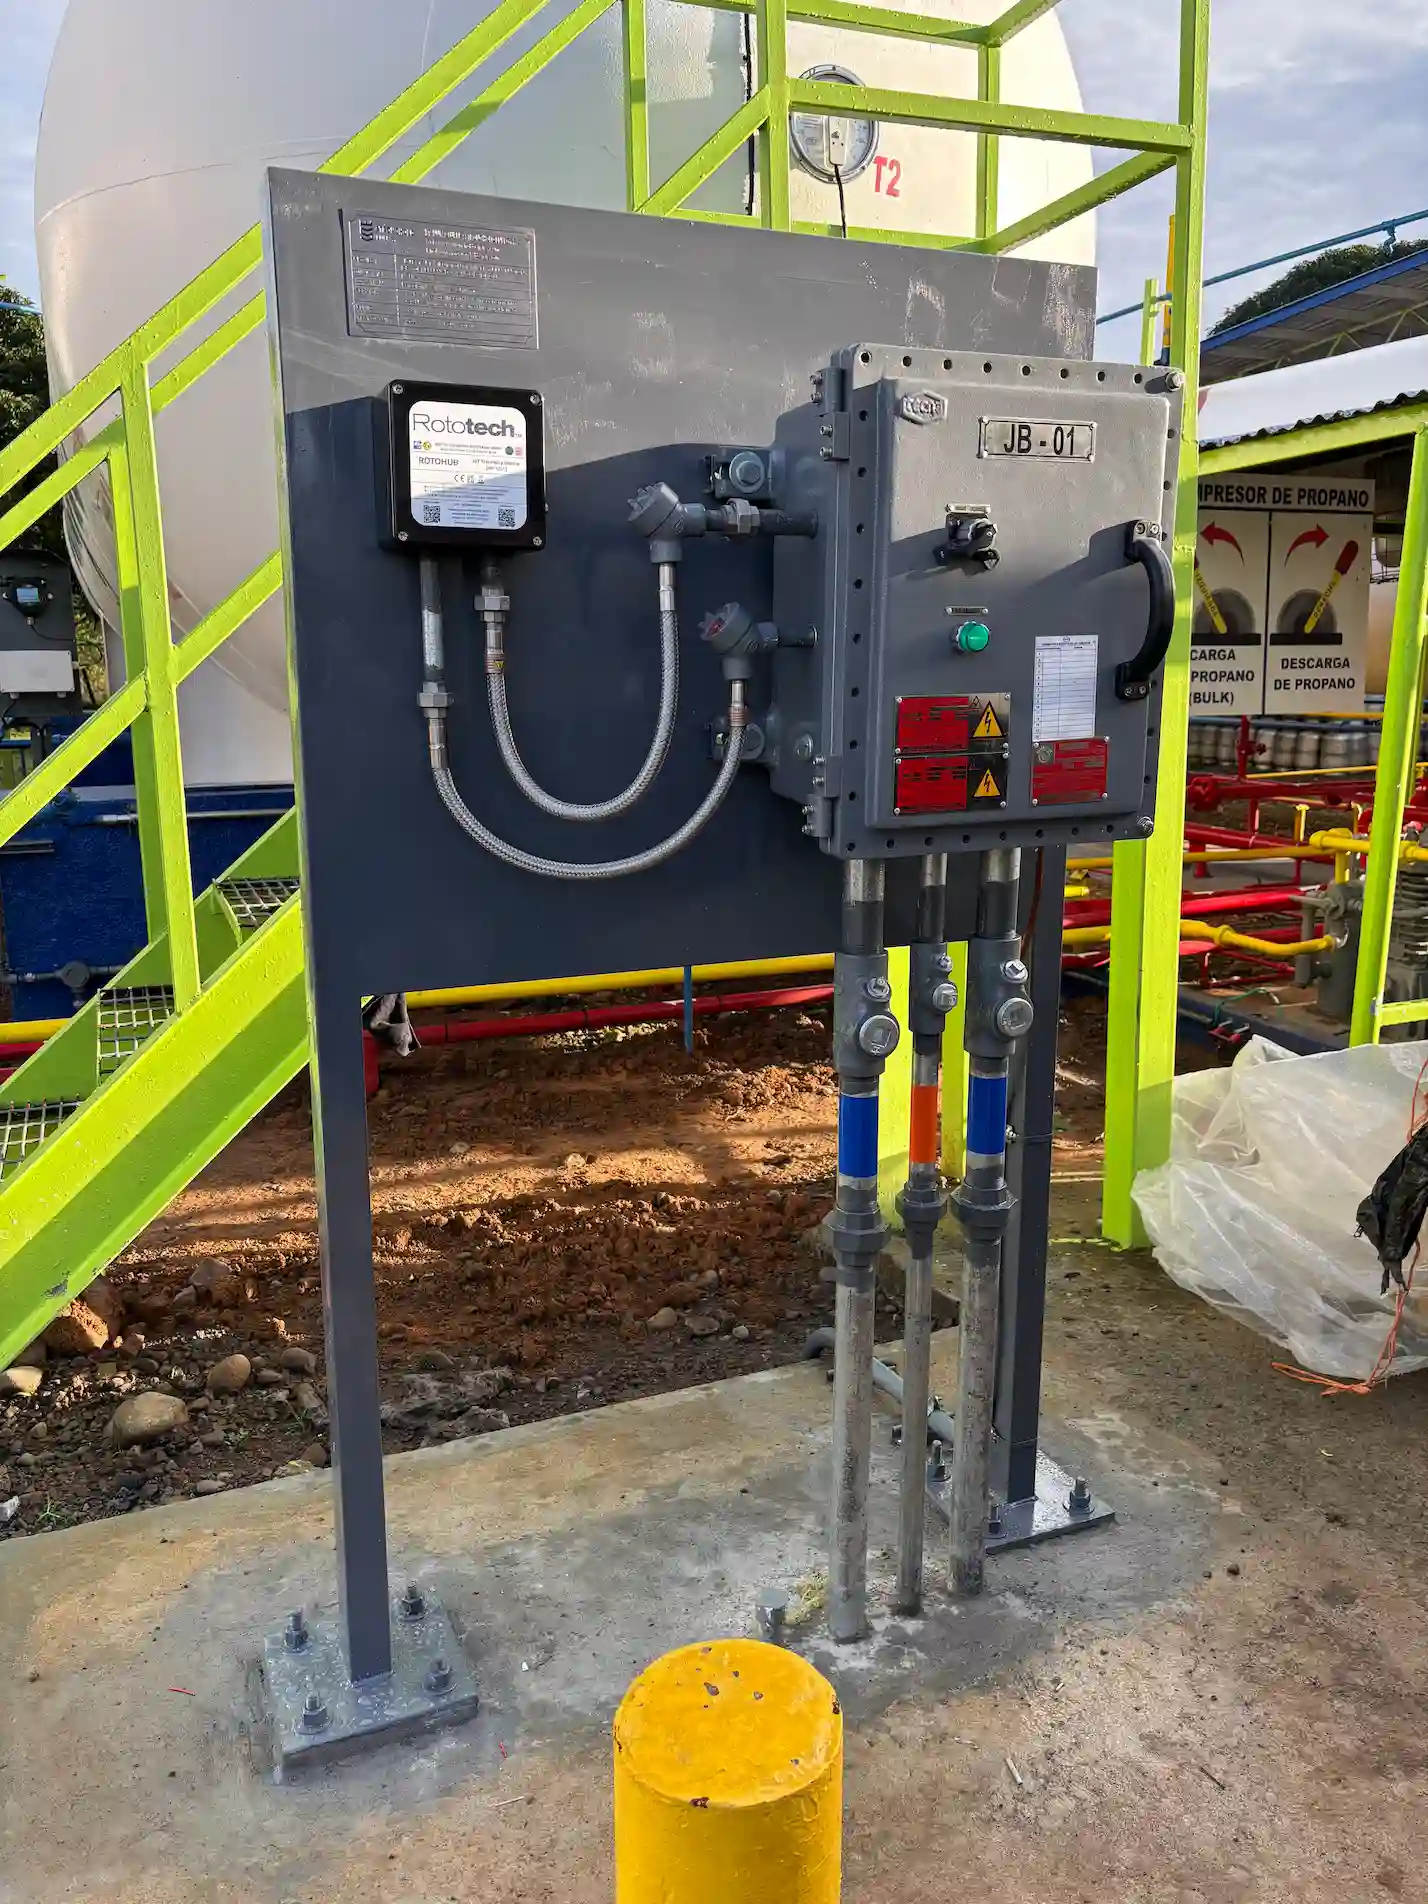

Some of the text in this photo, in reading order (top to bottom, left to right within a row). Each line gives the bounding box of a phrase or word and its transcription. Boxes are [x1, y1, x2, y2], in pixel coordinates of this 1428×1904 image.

[873, 156, 901, 197] T2
[413, 414, 513, 437] Rototech
[1003, 424, 1032, 454] JB
[1053, 426, 1075, 456] 01
[419, 457, 459, 466] ROTOHUB
[1199, 484, 1369, 508] PRESOR DE PROPANO
[1190, 649, 1236, 661] CARGA
[1281, 657, 1350, 670] DESCARGA
[1191, 670, 1255, 682] PROPANO
[1273, 677, 1356, 690] DE PROPANO
